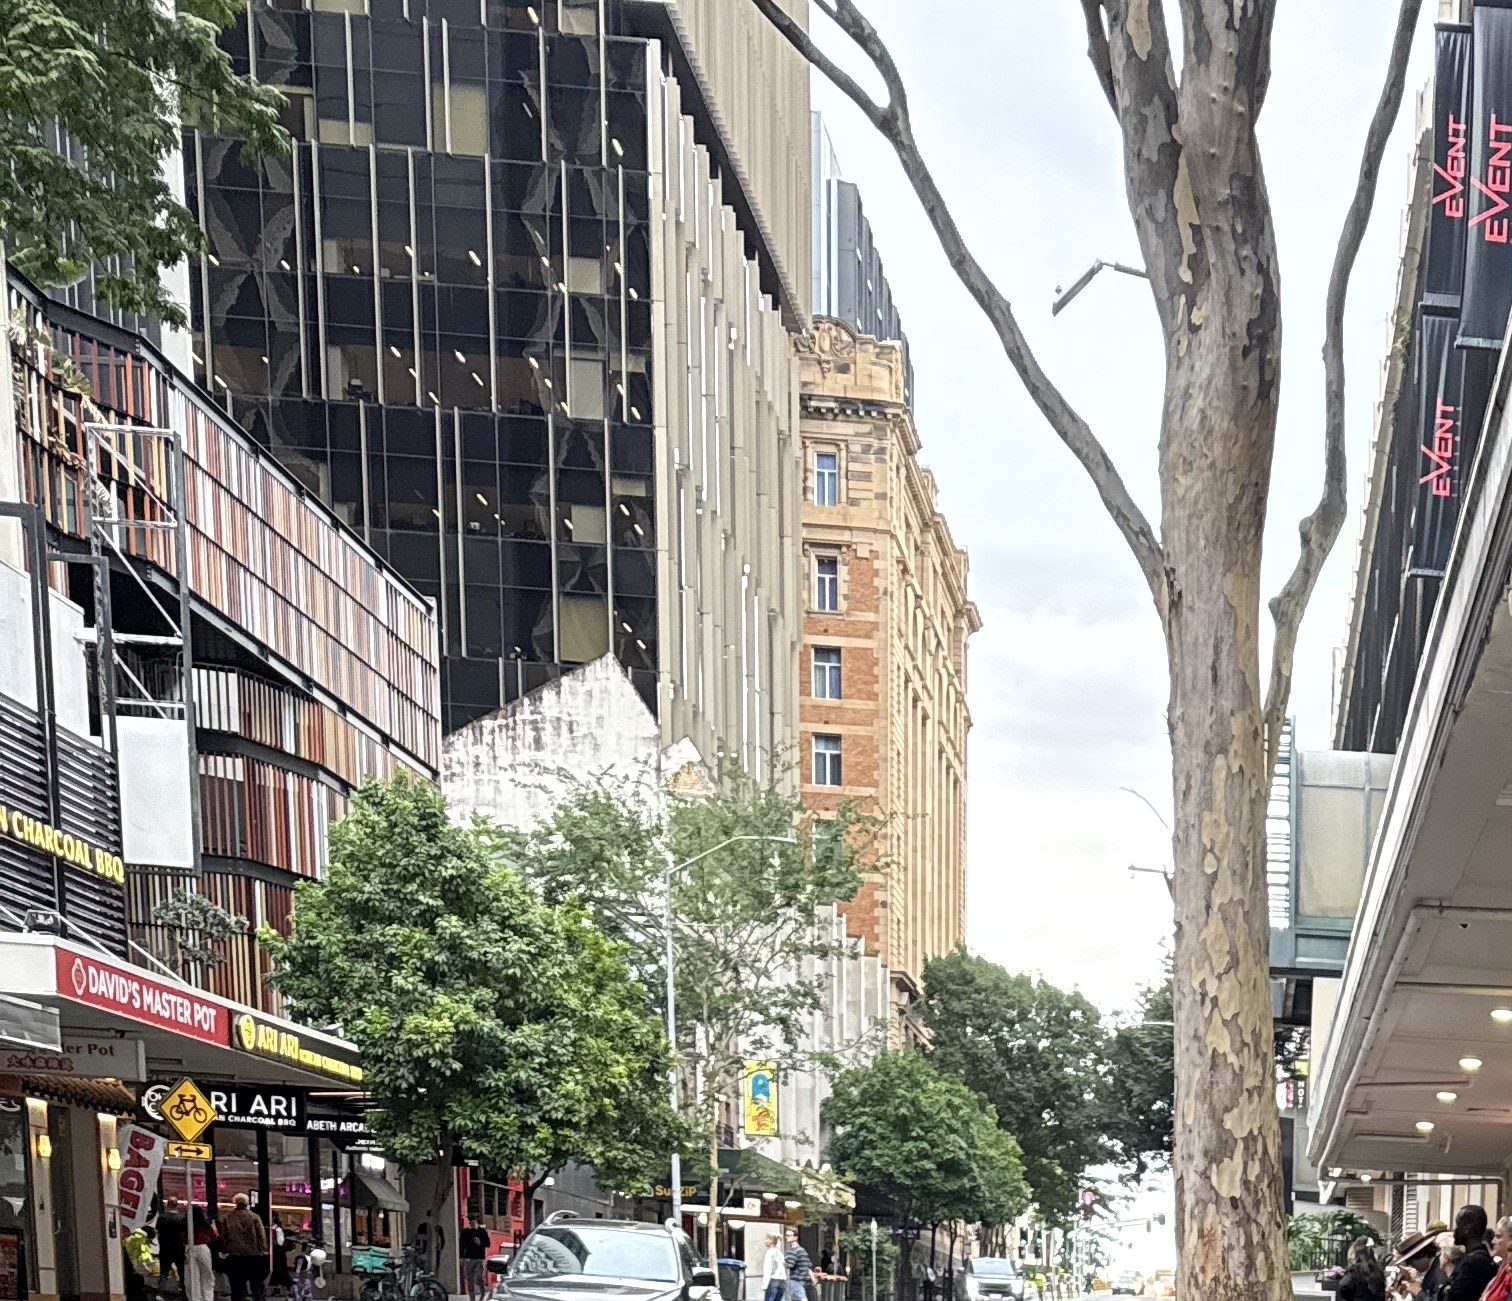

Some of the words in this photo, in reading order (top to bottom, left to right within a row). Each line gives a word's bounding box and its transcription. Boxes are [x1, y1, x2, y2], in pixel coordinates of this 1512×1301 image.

[1431, 112, 1467, 218] EVENT
[1468, 112, 1512, 243] EVENT
[1419, 397, 1455, 497] EVENT
[12, 811, 93, 869] CHARCOAL
[95, 847, 125, 883] BBQ
[88, 966, 141, 1009] DAVID'S
[142, 985, 192, 1026] MASTER
[193, 1006, 217, 1034] POT
[257, 1024, 278, 1053] ARI
[280, 1031, 299, 1060] ARI
[210, 1091, 237, 1113] RI
[249, 1094, 297, 1117] ARI
[227, 1115, 276, 1125] CHARCOAL
[306, 1119, 338, 1132] ABETH
[339, 1121, 378, 1134] ARCA
